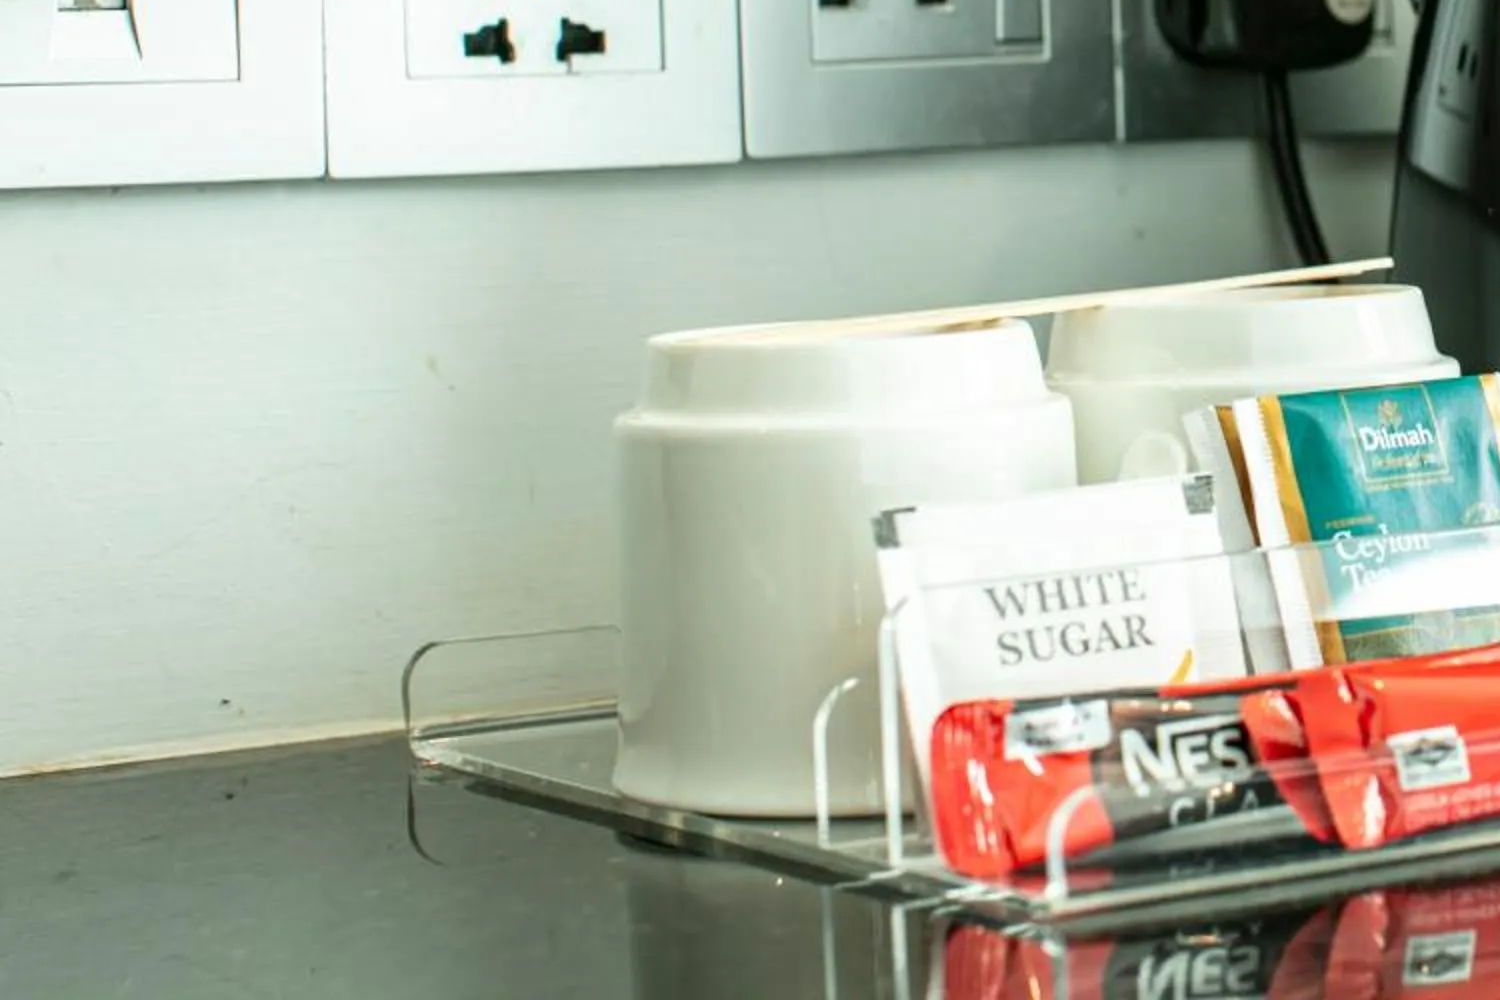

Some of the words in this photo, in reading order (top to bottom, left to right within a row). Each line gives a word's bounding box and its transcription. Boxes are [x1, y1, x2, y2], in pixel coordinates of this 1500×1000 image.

[1359, 422, 1435, 451] Dilmah
[984, 568, 1147, 621] WHITE
[996, 614, 1155, 667] SUGAR
